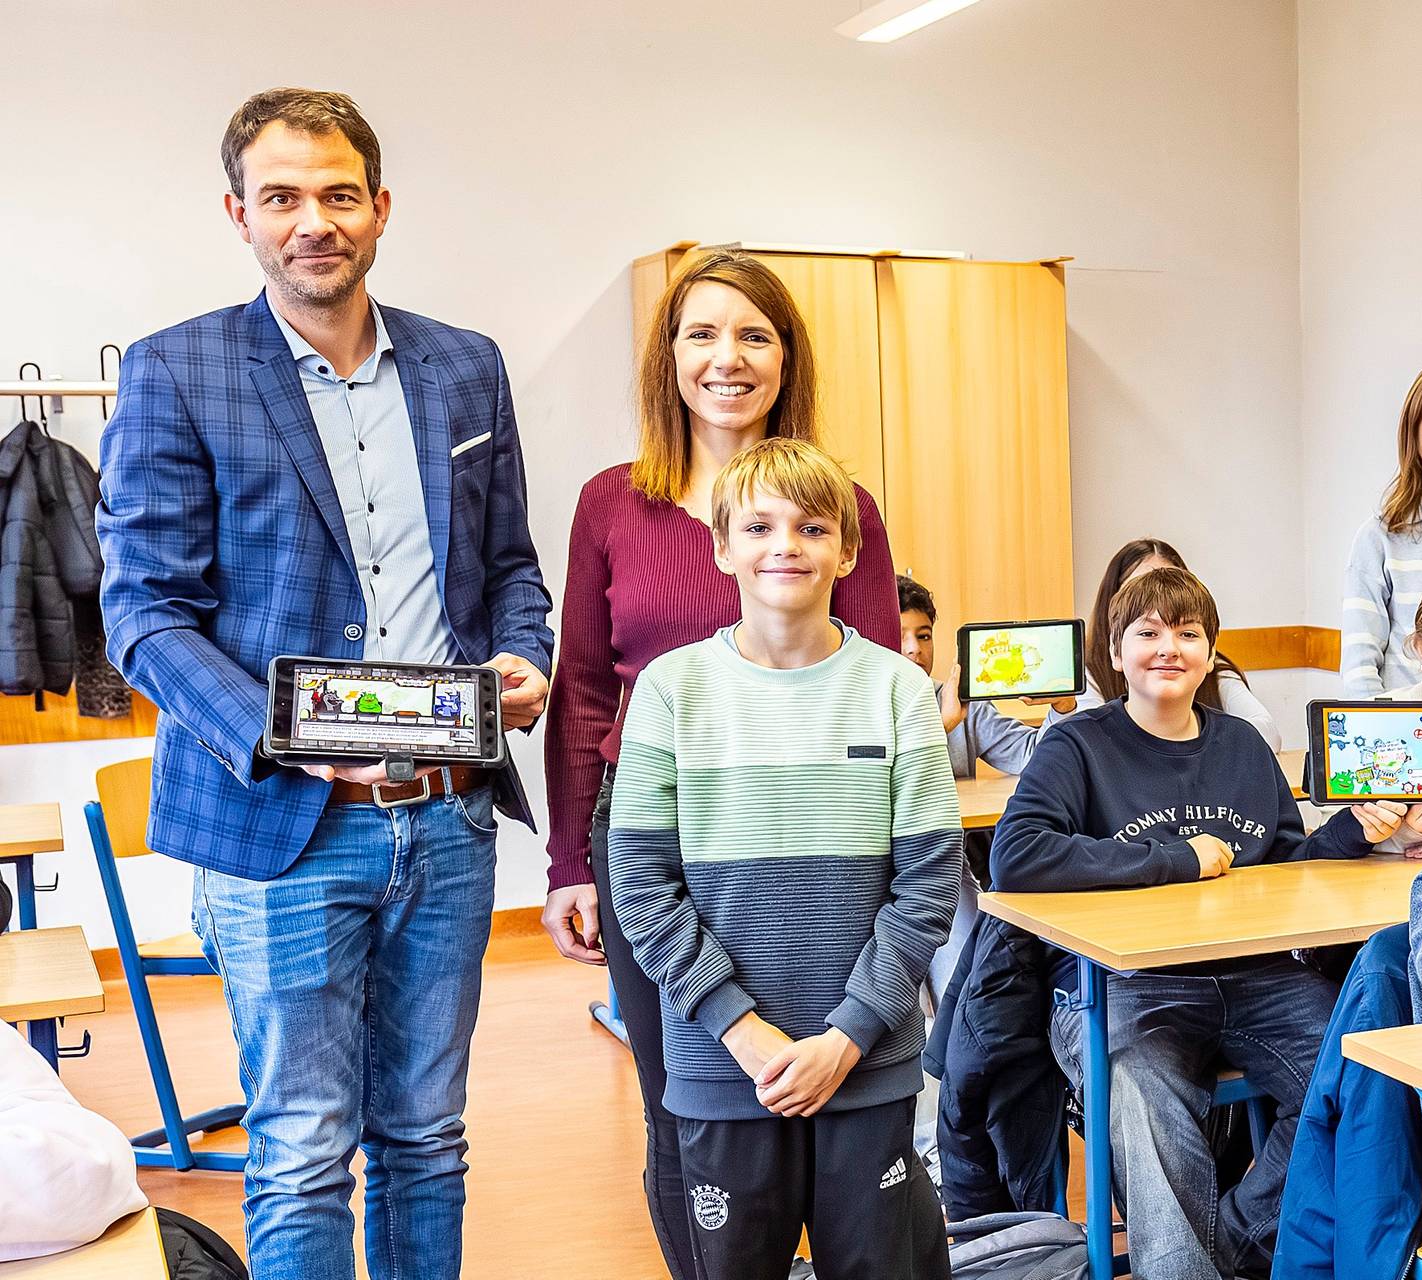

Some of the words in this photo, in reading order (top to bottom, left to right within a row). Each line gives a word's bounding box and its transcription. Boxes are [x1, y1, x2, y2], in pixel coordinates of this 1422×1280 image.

[1113, 807, 1177, 844] TOMMY
[1185, 804, 1267, 839] HILFIGER
[1178, 825, 1204, 836] EST.
[879, 1172, 907, 1189] adidas
